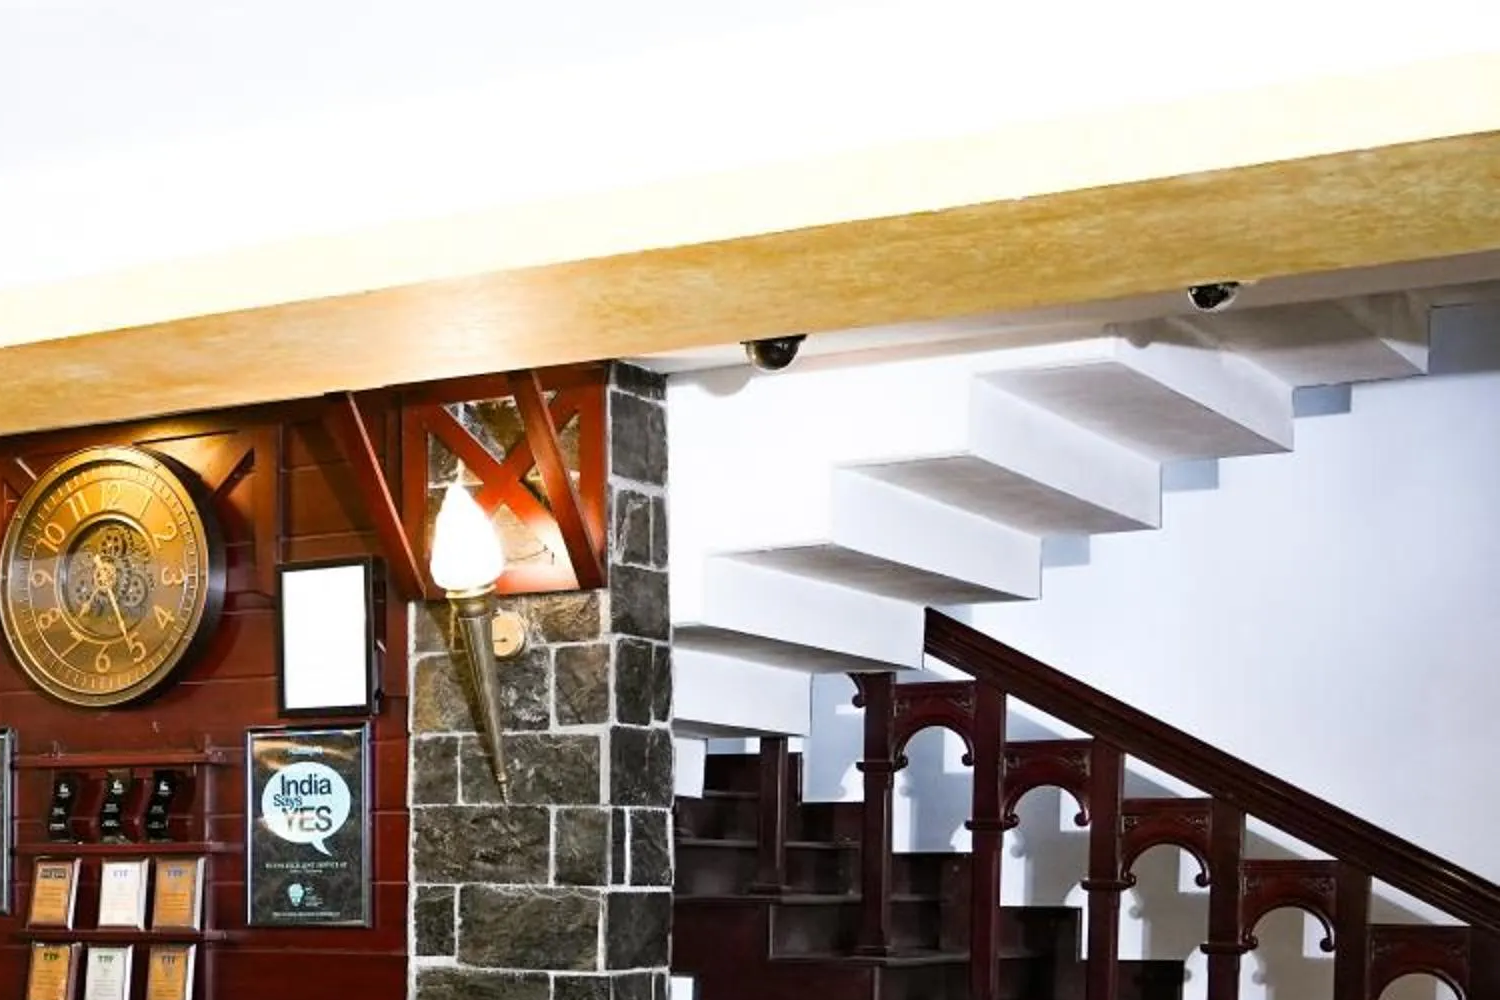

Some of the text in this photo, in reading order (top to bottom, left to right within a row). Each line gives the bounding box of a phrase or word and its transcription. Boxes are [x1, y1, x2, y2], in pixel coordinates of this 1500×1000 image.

[67, 491, 90, 521] 11
[101, 482, 122, 509] 12
[36, 522, 66, 552] 10
[152, 523, 177, 549] 2
[30, 568, 55, 588] 9
[161, 567, 185, 586] 3
[38, 607, 61, 629] 8
[153, 603, 176, 630] 4
[95, 643, 112, 673] 6
[128, 631, 147, 663] 5
[281, 773, 333, 796] India
[273, 793, 303, 809] Says
[281, 806, 333, 832] YES
